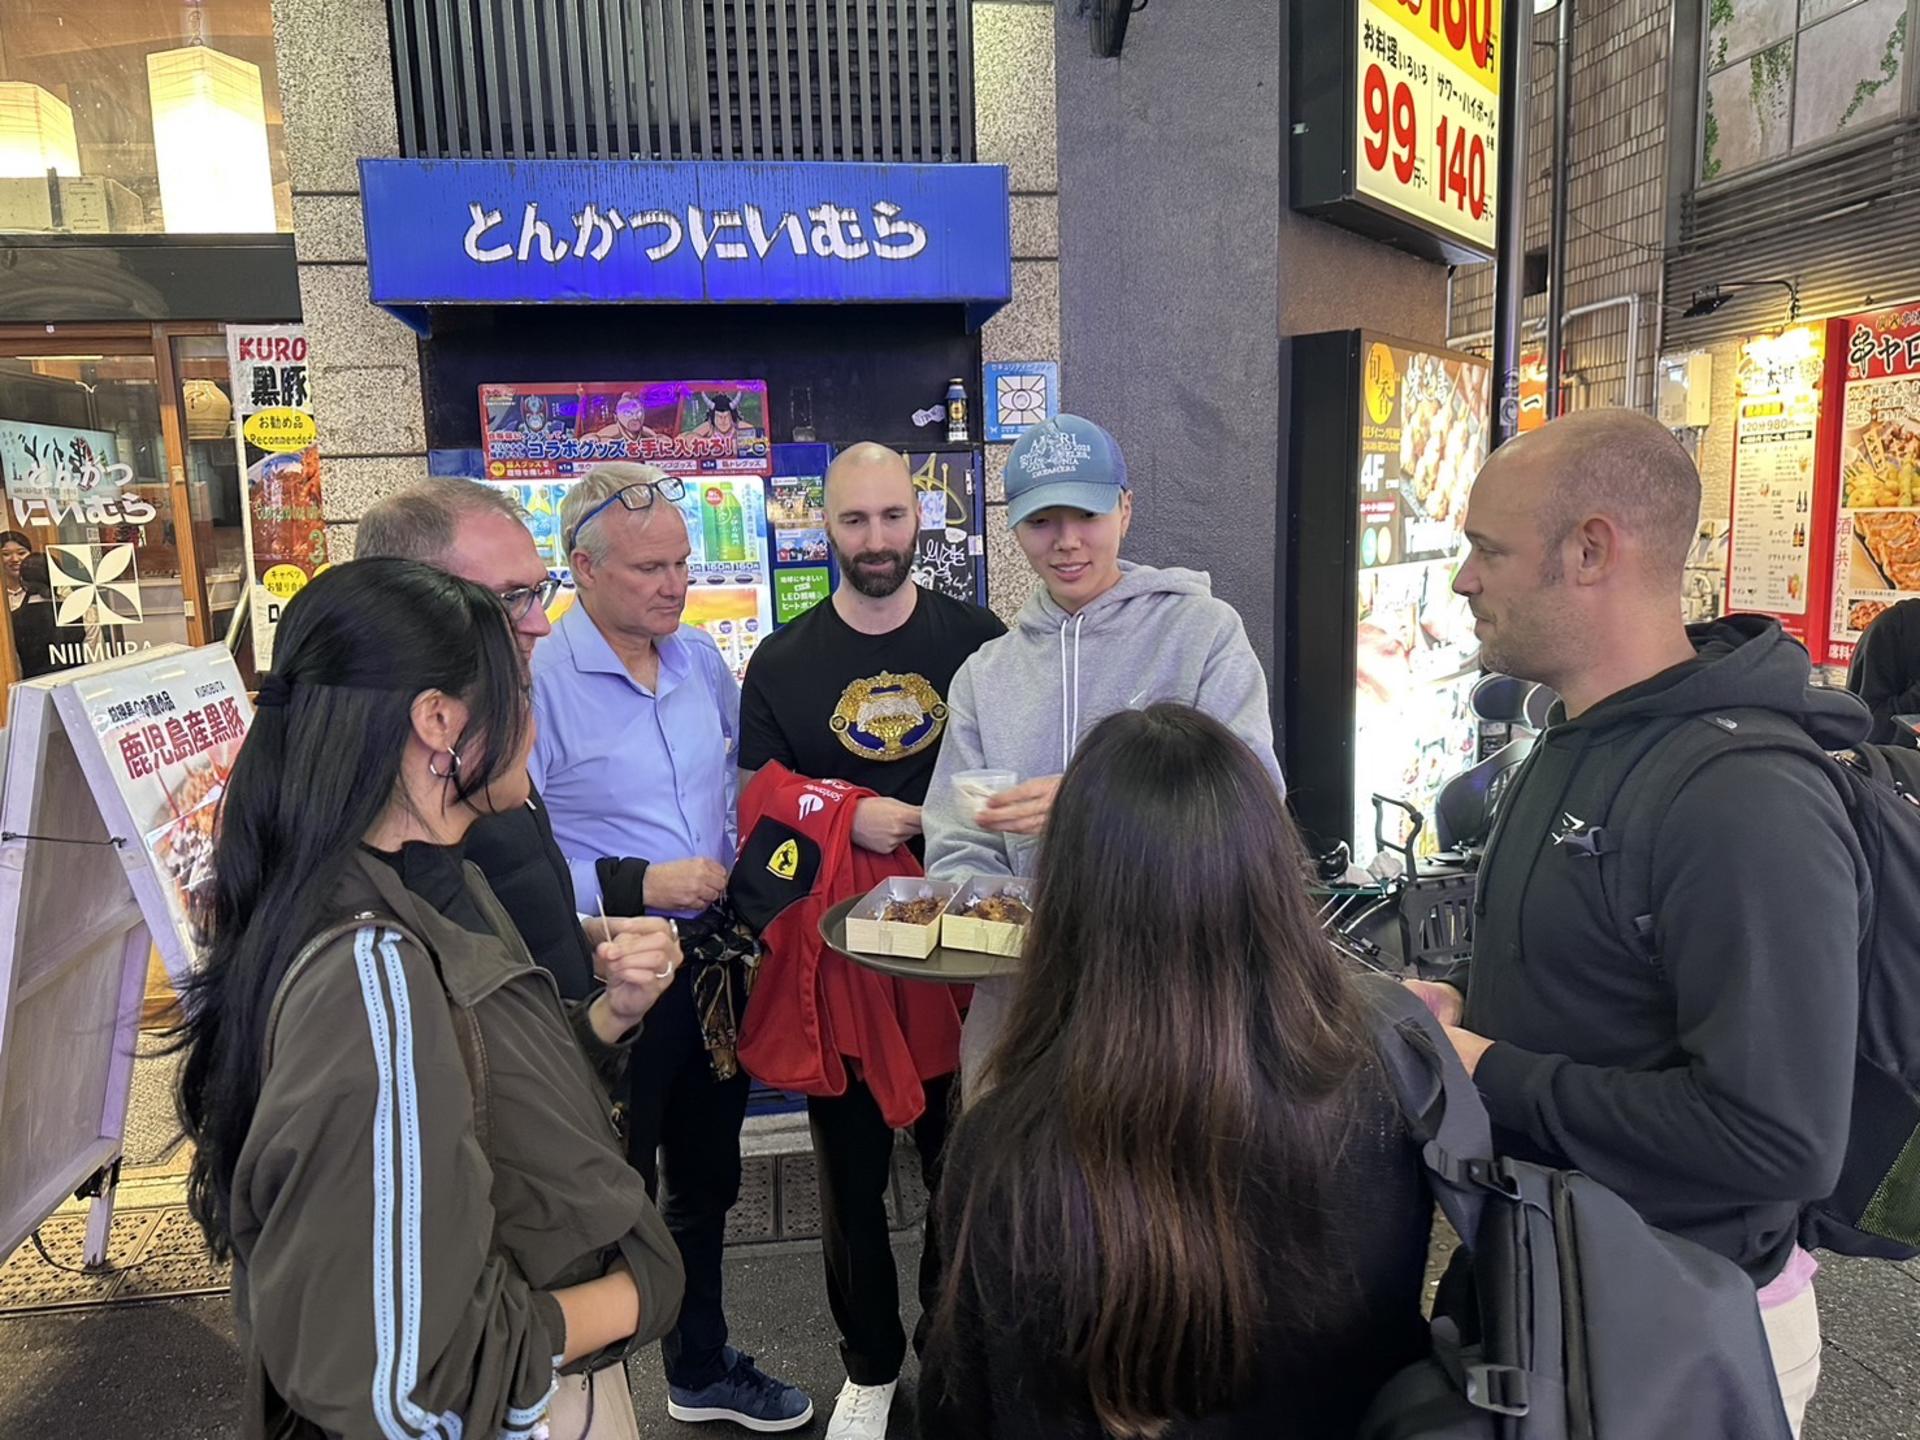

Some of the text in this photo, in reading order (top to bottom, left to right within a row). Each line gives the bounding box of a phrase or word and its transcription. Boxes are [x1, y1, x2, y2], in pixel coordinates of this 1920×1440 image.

[1363, 19, 1428, 85] お料理いろいろ
[463, 201, 927, 263] とんかつにいむら
[239, 337, 308, 361] KURO
[251, 366, 308, 406] 黒豚
[259, 416, 304, 429] お勧め品
[13, 493, 156, 527] にいむら
[118, 696, 245, 780] 鹿児島産黒豚
